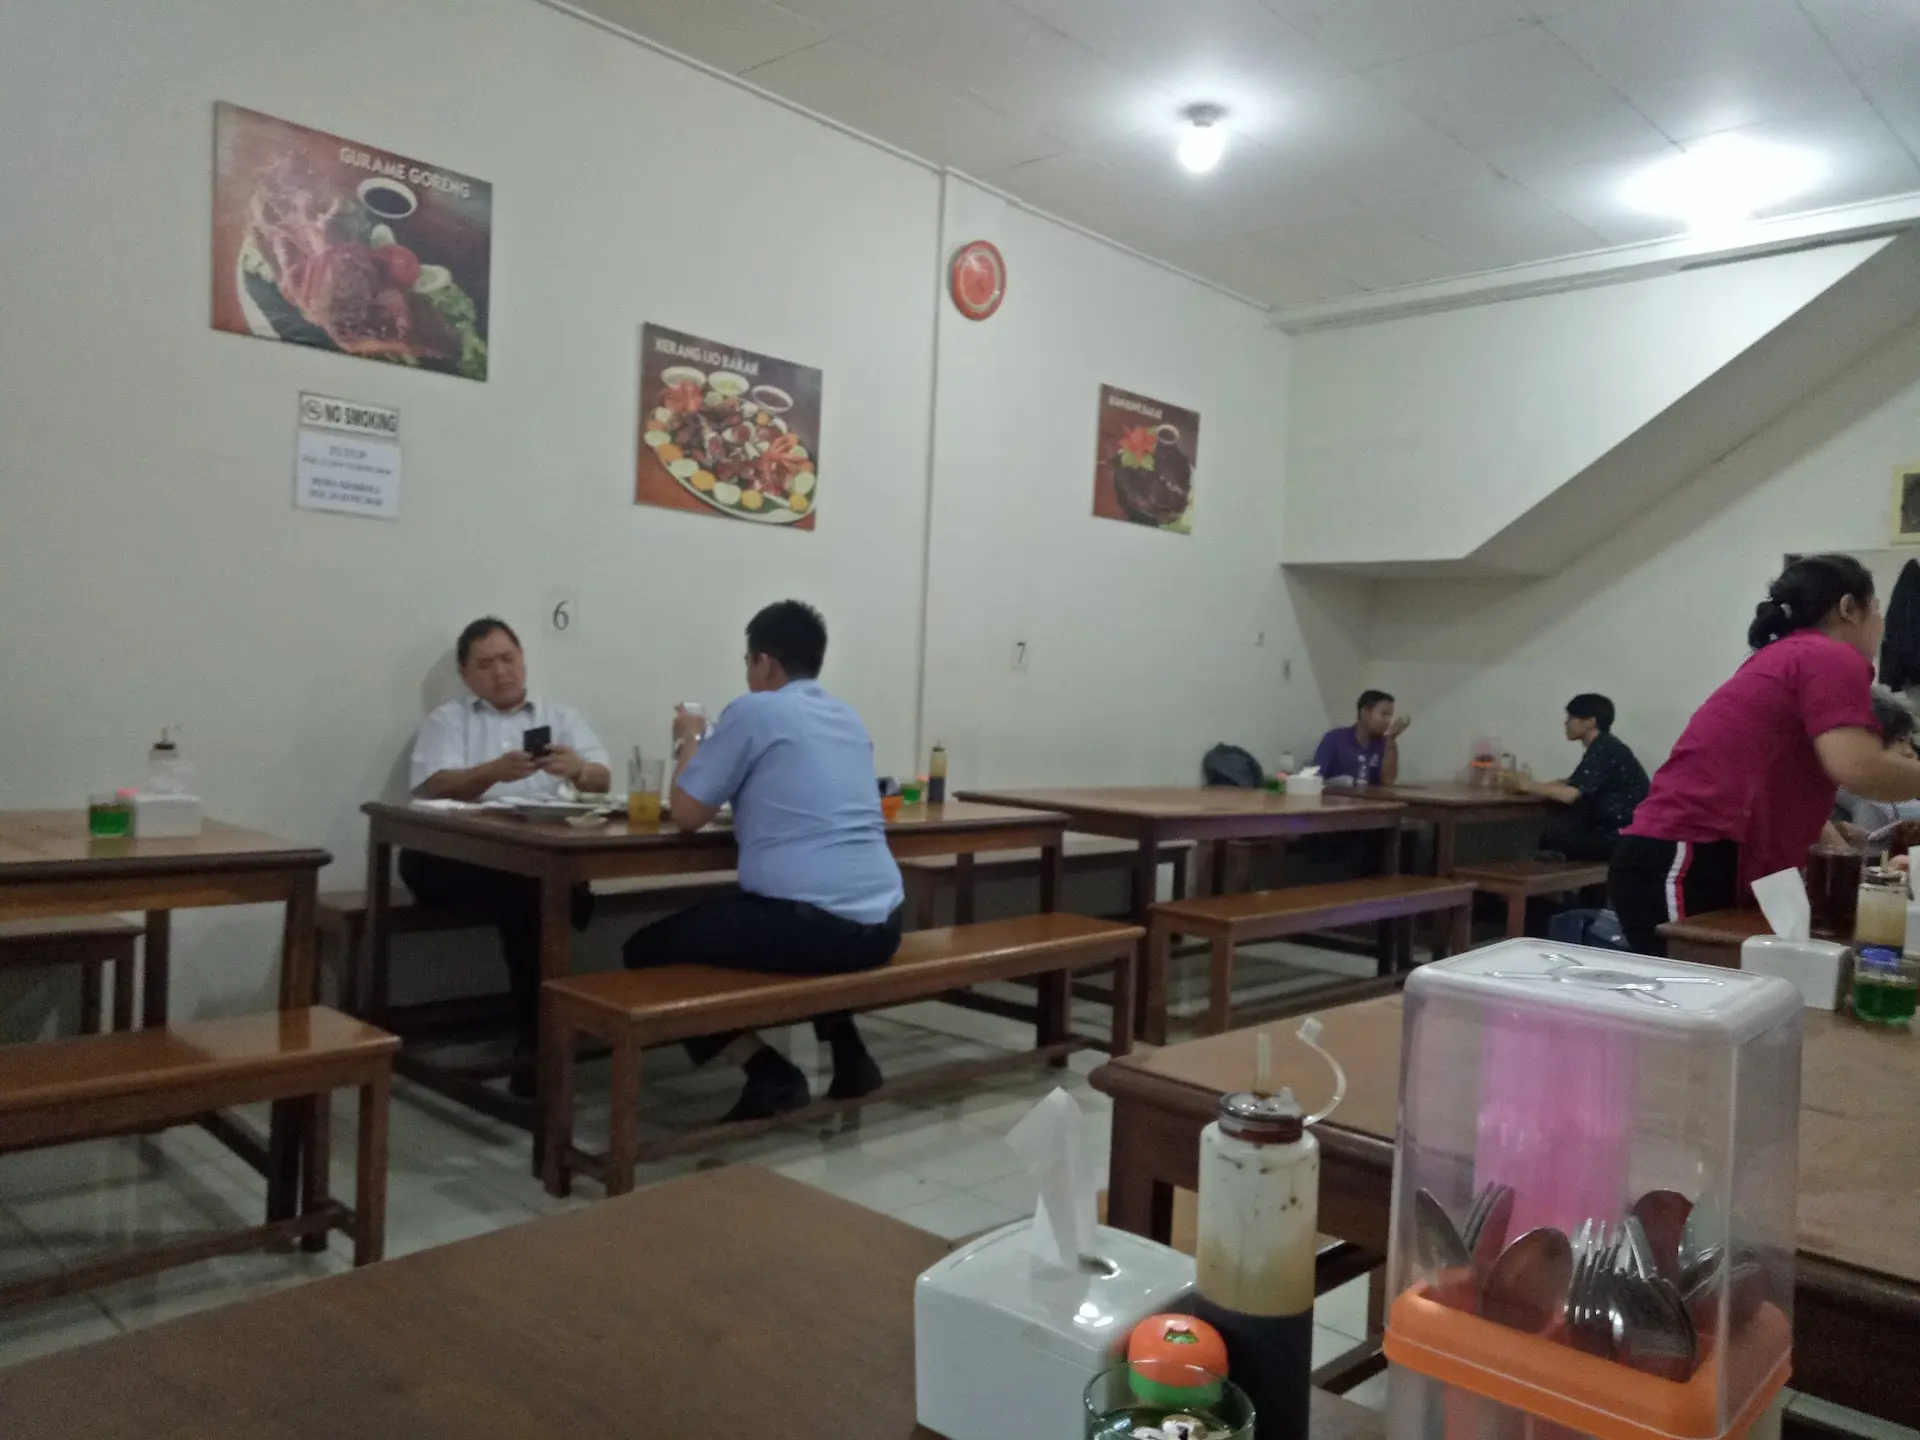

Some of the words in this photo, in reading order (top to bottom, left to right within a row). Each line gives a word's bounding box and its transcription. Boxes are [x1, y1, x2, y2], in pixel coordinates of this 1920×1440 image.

[340, 146, 406, 180] GURAME
[407, 167, 471, 199] GORENG
[324, 403, 342, 423] NO
[344, 407, 398, 432] SMOKING
[552, 599, 571, 631] 6
[1015, 641, 1027, 666] 7
